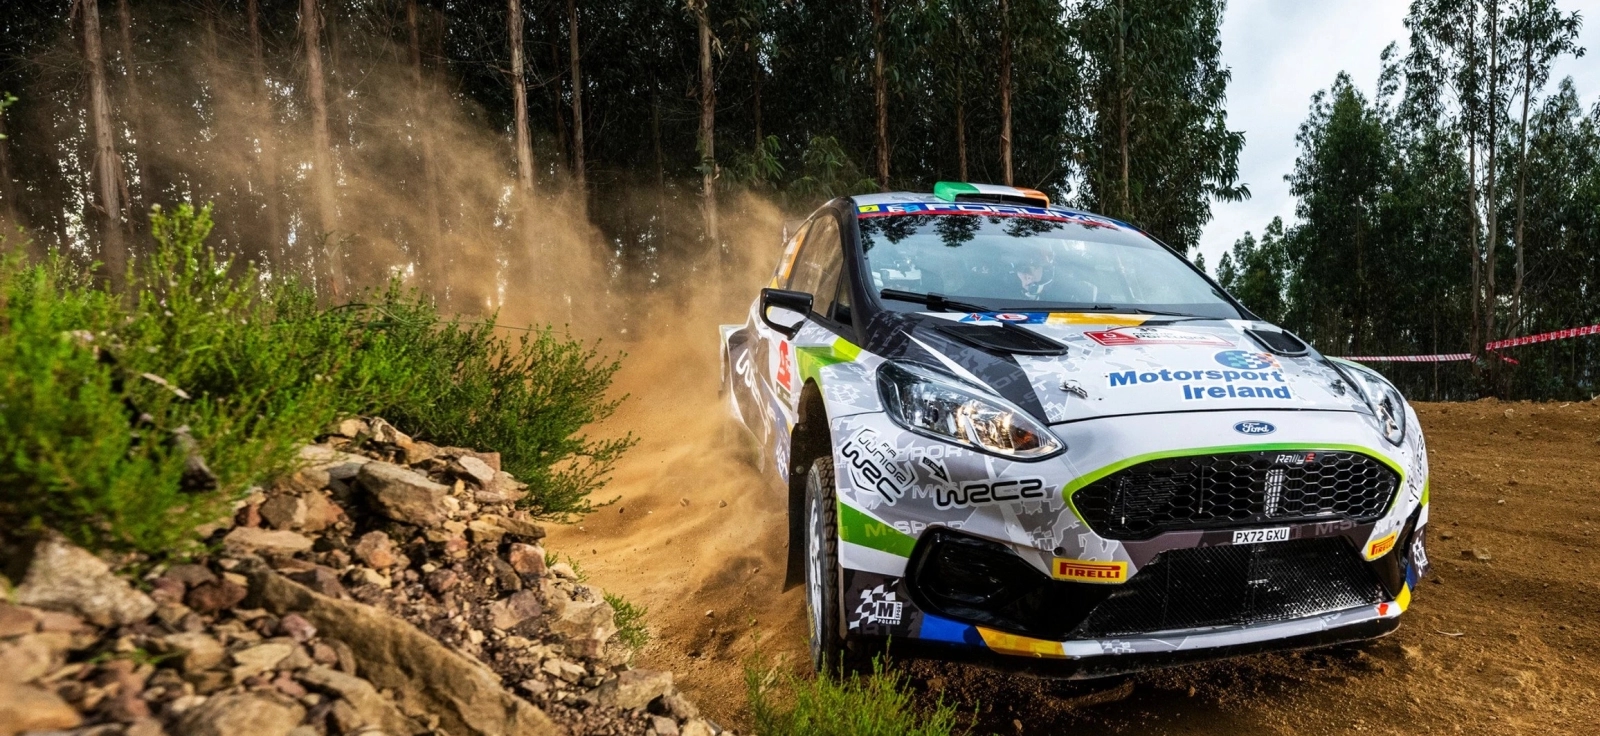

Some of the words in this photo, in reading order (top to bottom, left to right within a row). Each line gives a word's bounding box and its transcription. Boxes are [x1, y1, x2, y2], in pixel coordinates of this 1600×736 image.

[1109, 369, 1286, 387] Motorsport
[1182, 384, 1292, 400] Ireland
[1241, 422, 1270, 433] Ford
[881, 442, 897, 459] FIA
[858, 437, 907, 485] JUNIOR
[841, 441, 902, 503] WRC
[936, 478, 1044, 507] WRC2
[1235, 531, 1264, 543] PX72
[1266, 528, 1288, 541] GXU
[1059, 562, 1121, 579] PIRELLI
